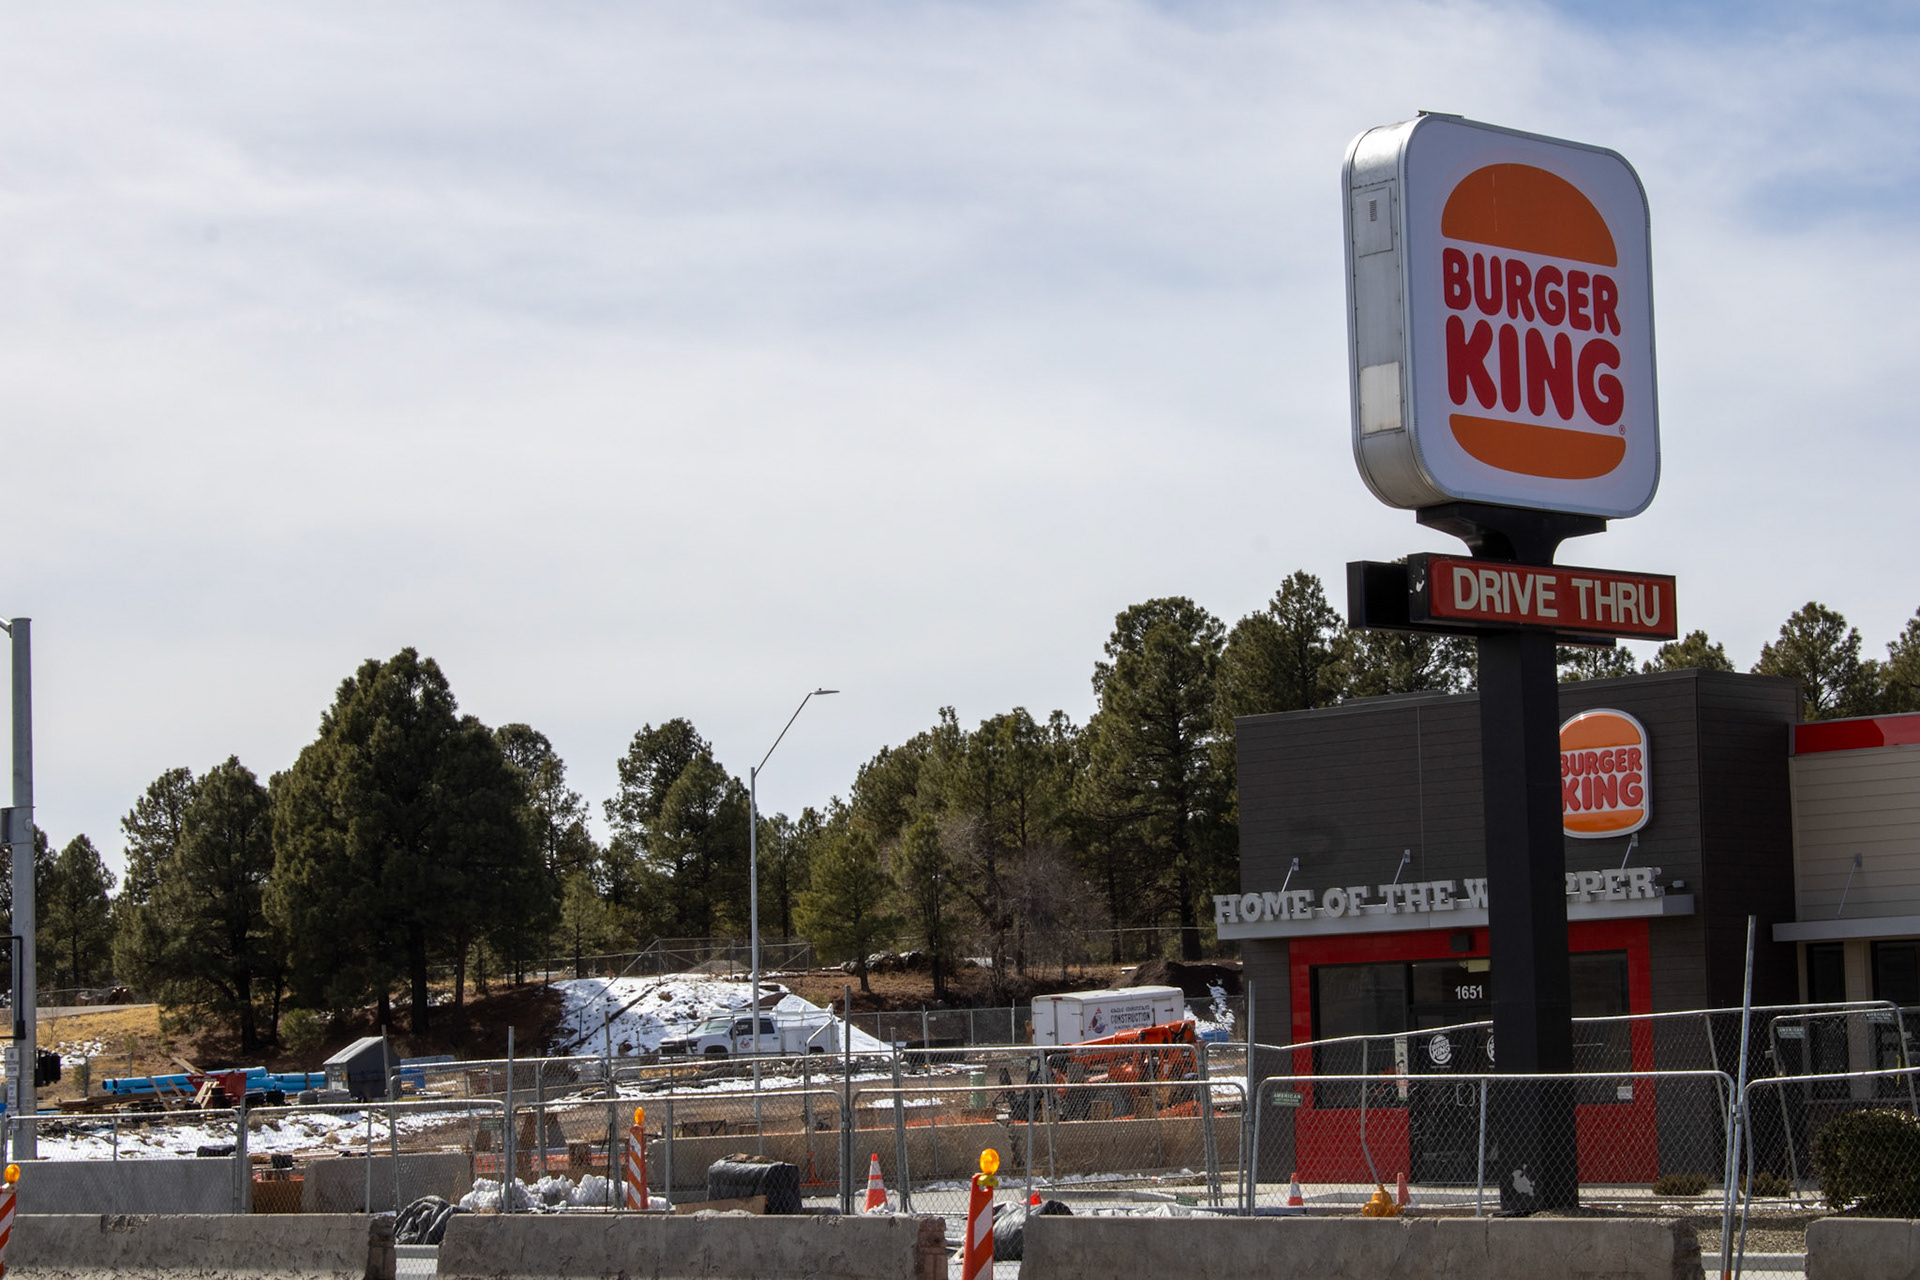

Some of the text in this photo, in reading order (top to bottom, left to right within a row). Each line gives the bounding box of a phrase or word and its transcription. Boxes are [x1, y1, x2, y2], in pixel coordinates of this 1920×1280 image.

[1442, 247, 1622, 337] BURGER
[1445, 314, 1625, 426] KING
[1452, 566, 1661, 627] DRIVE THRU
[1560, 747, 1643, 778] BURGER
[1561, 772, 1644, 812] KING
[1212, 889, 1315, 924] HOME
[1322, 885, 1370, 919] OF
[1378, 879, 1456, 915] THE
[1455, 984, 1483, 1000] 1651
[1110, 1012, 1151, 1024] CONSTRUCTION
